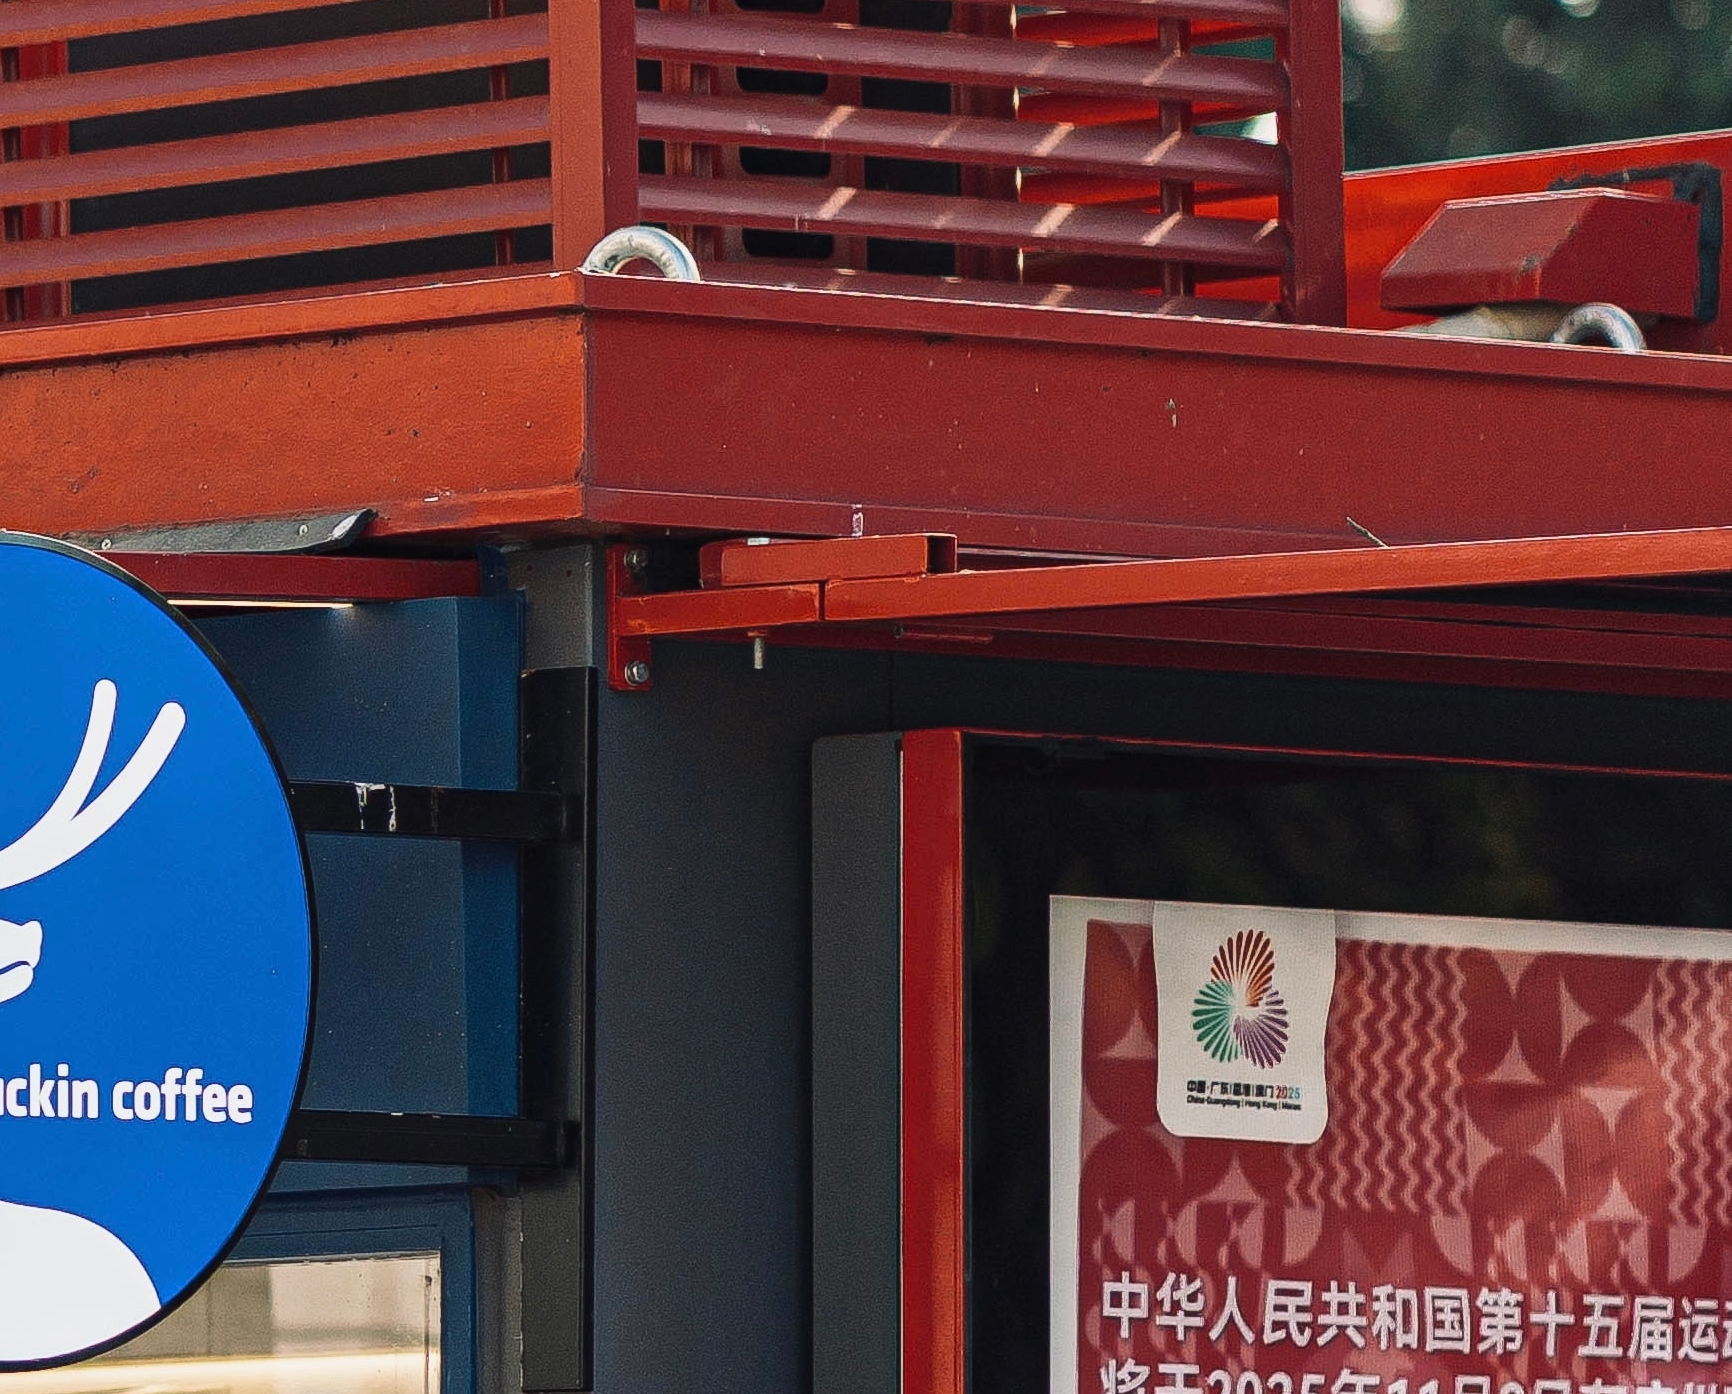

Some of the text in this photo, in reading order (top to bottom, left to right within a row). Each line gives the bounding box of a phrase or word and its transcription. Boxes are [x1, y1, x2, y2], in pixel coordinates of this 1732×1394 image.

[111, 1066, 255, 1125] coffee
[1098, 1271, 1732, 1364] 中华人民共和国第十五届运
